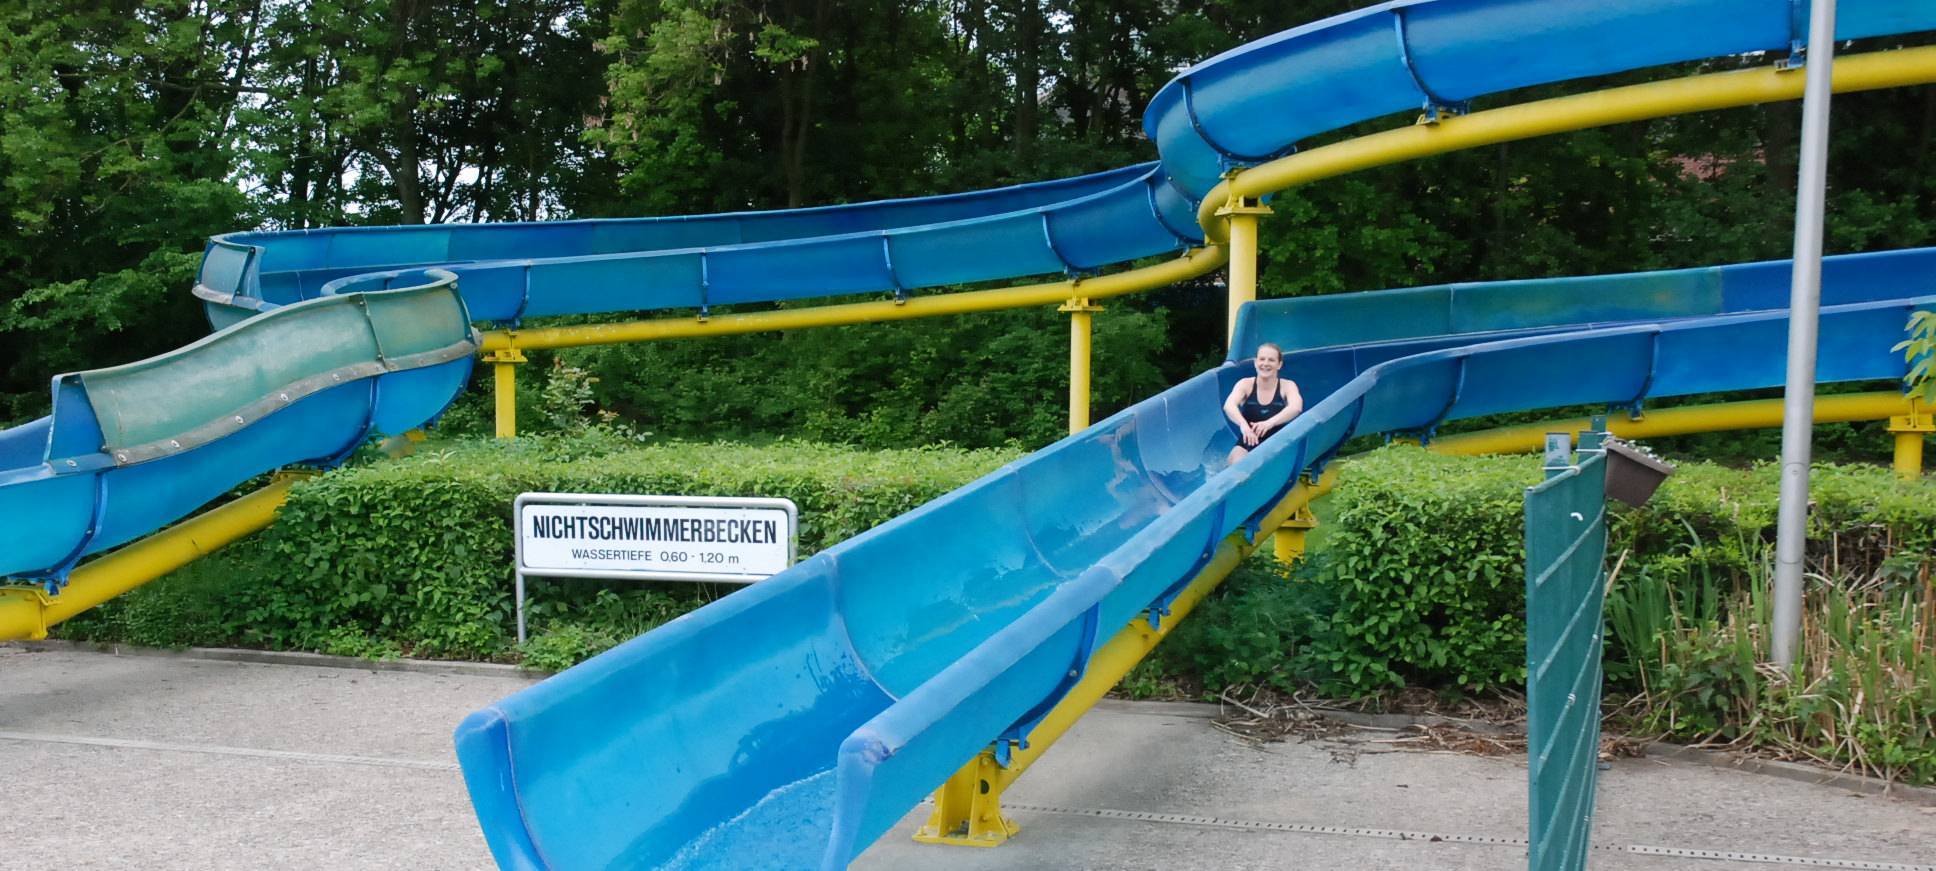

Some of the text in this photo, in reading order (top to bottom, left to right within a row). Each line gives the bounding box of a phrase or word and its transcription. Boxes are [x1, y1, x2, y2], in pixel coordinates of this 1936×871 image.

[533, 515, 777, 544] NICHTSCHWIMMERBECKEN
[571, 549, 652, 561] WASSERTIEFE
[728, 555, 740, 564] m
